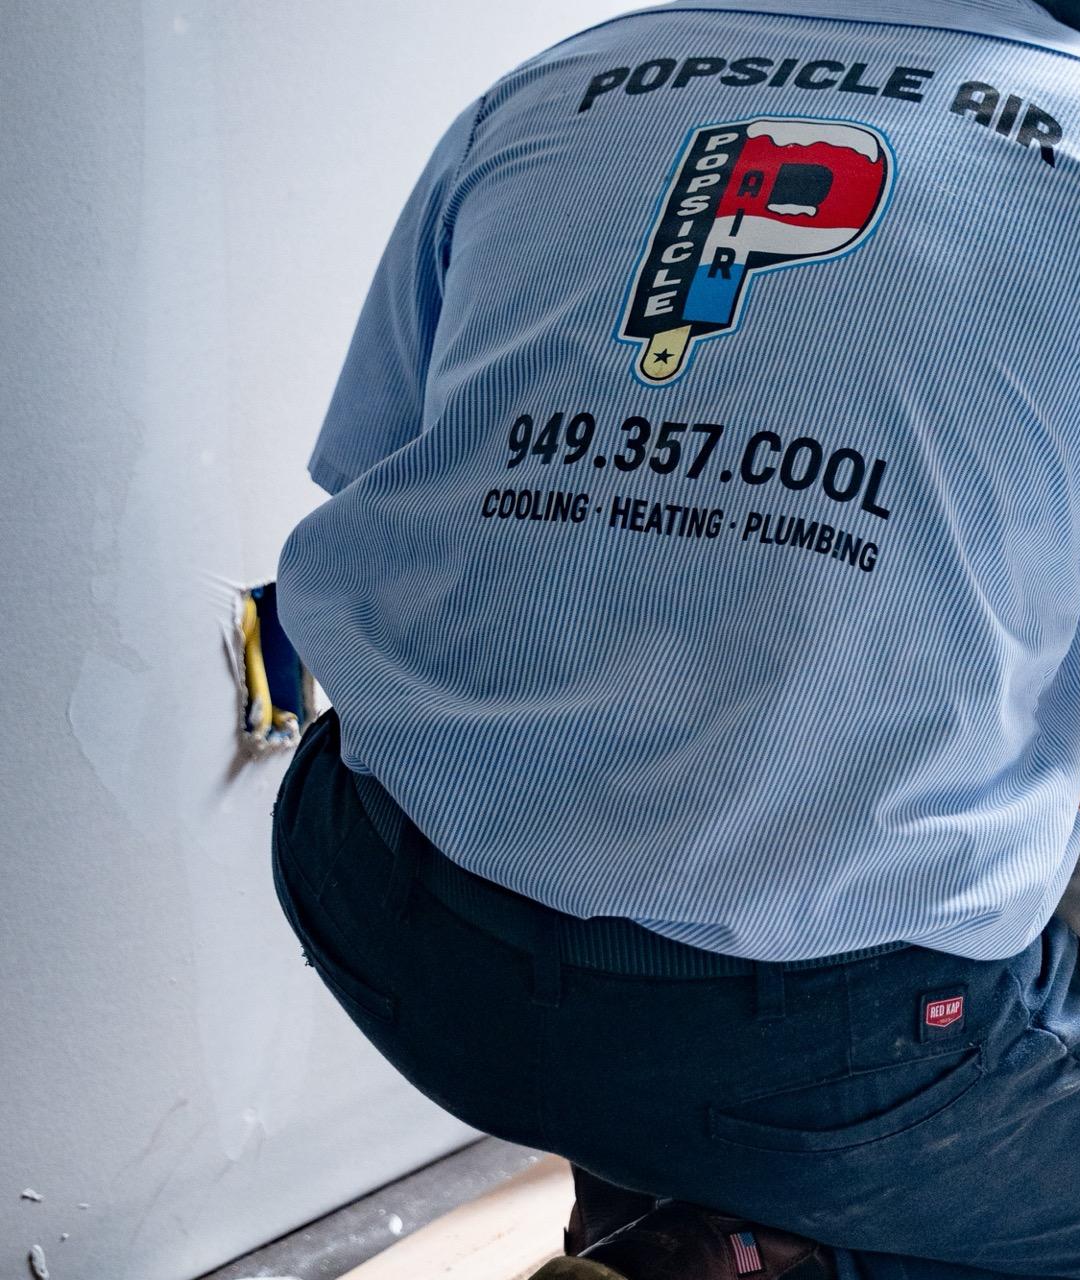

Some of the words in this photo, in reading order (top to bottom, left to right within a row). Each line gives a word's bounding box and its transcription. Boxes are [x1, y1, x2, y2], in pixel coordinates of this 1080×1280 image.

[577, 57, 935, 114] POPSICLE
[948, 80, 1064, 168] AIR
[644, 132, 740, 318] POPSICLE
[708, 170, 763, 280] AIR
[482, 488, 589, 523] COOLING
[610, 496, 723, 539] HEATING
[508, 412, 891, 520] 949.357.COOL
[930, 1005, 944, 1018] RED
[946, 1002, 960, 1015] KAP
